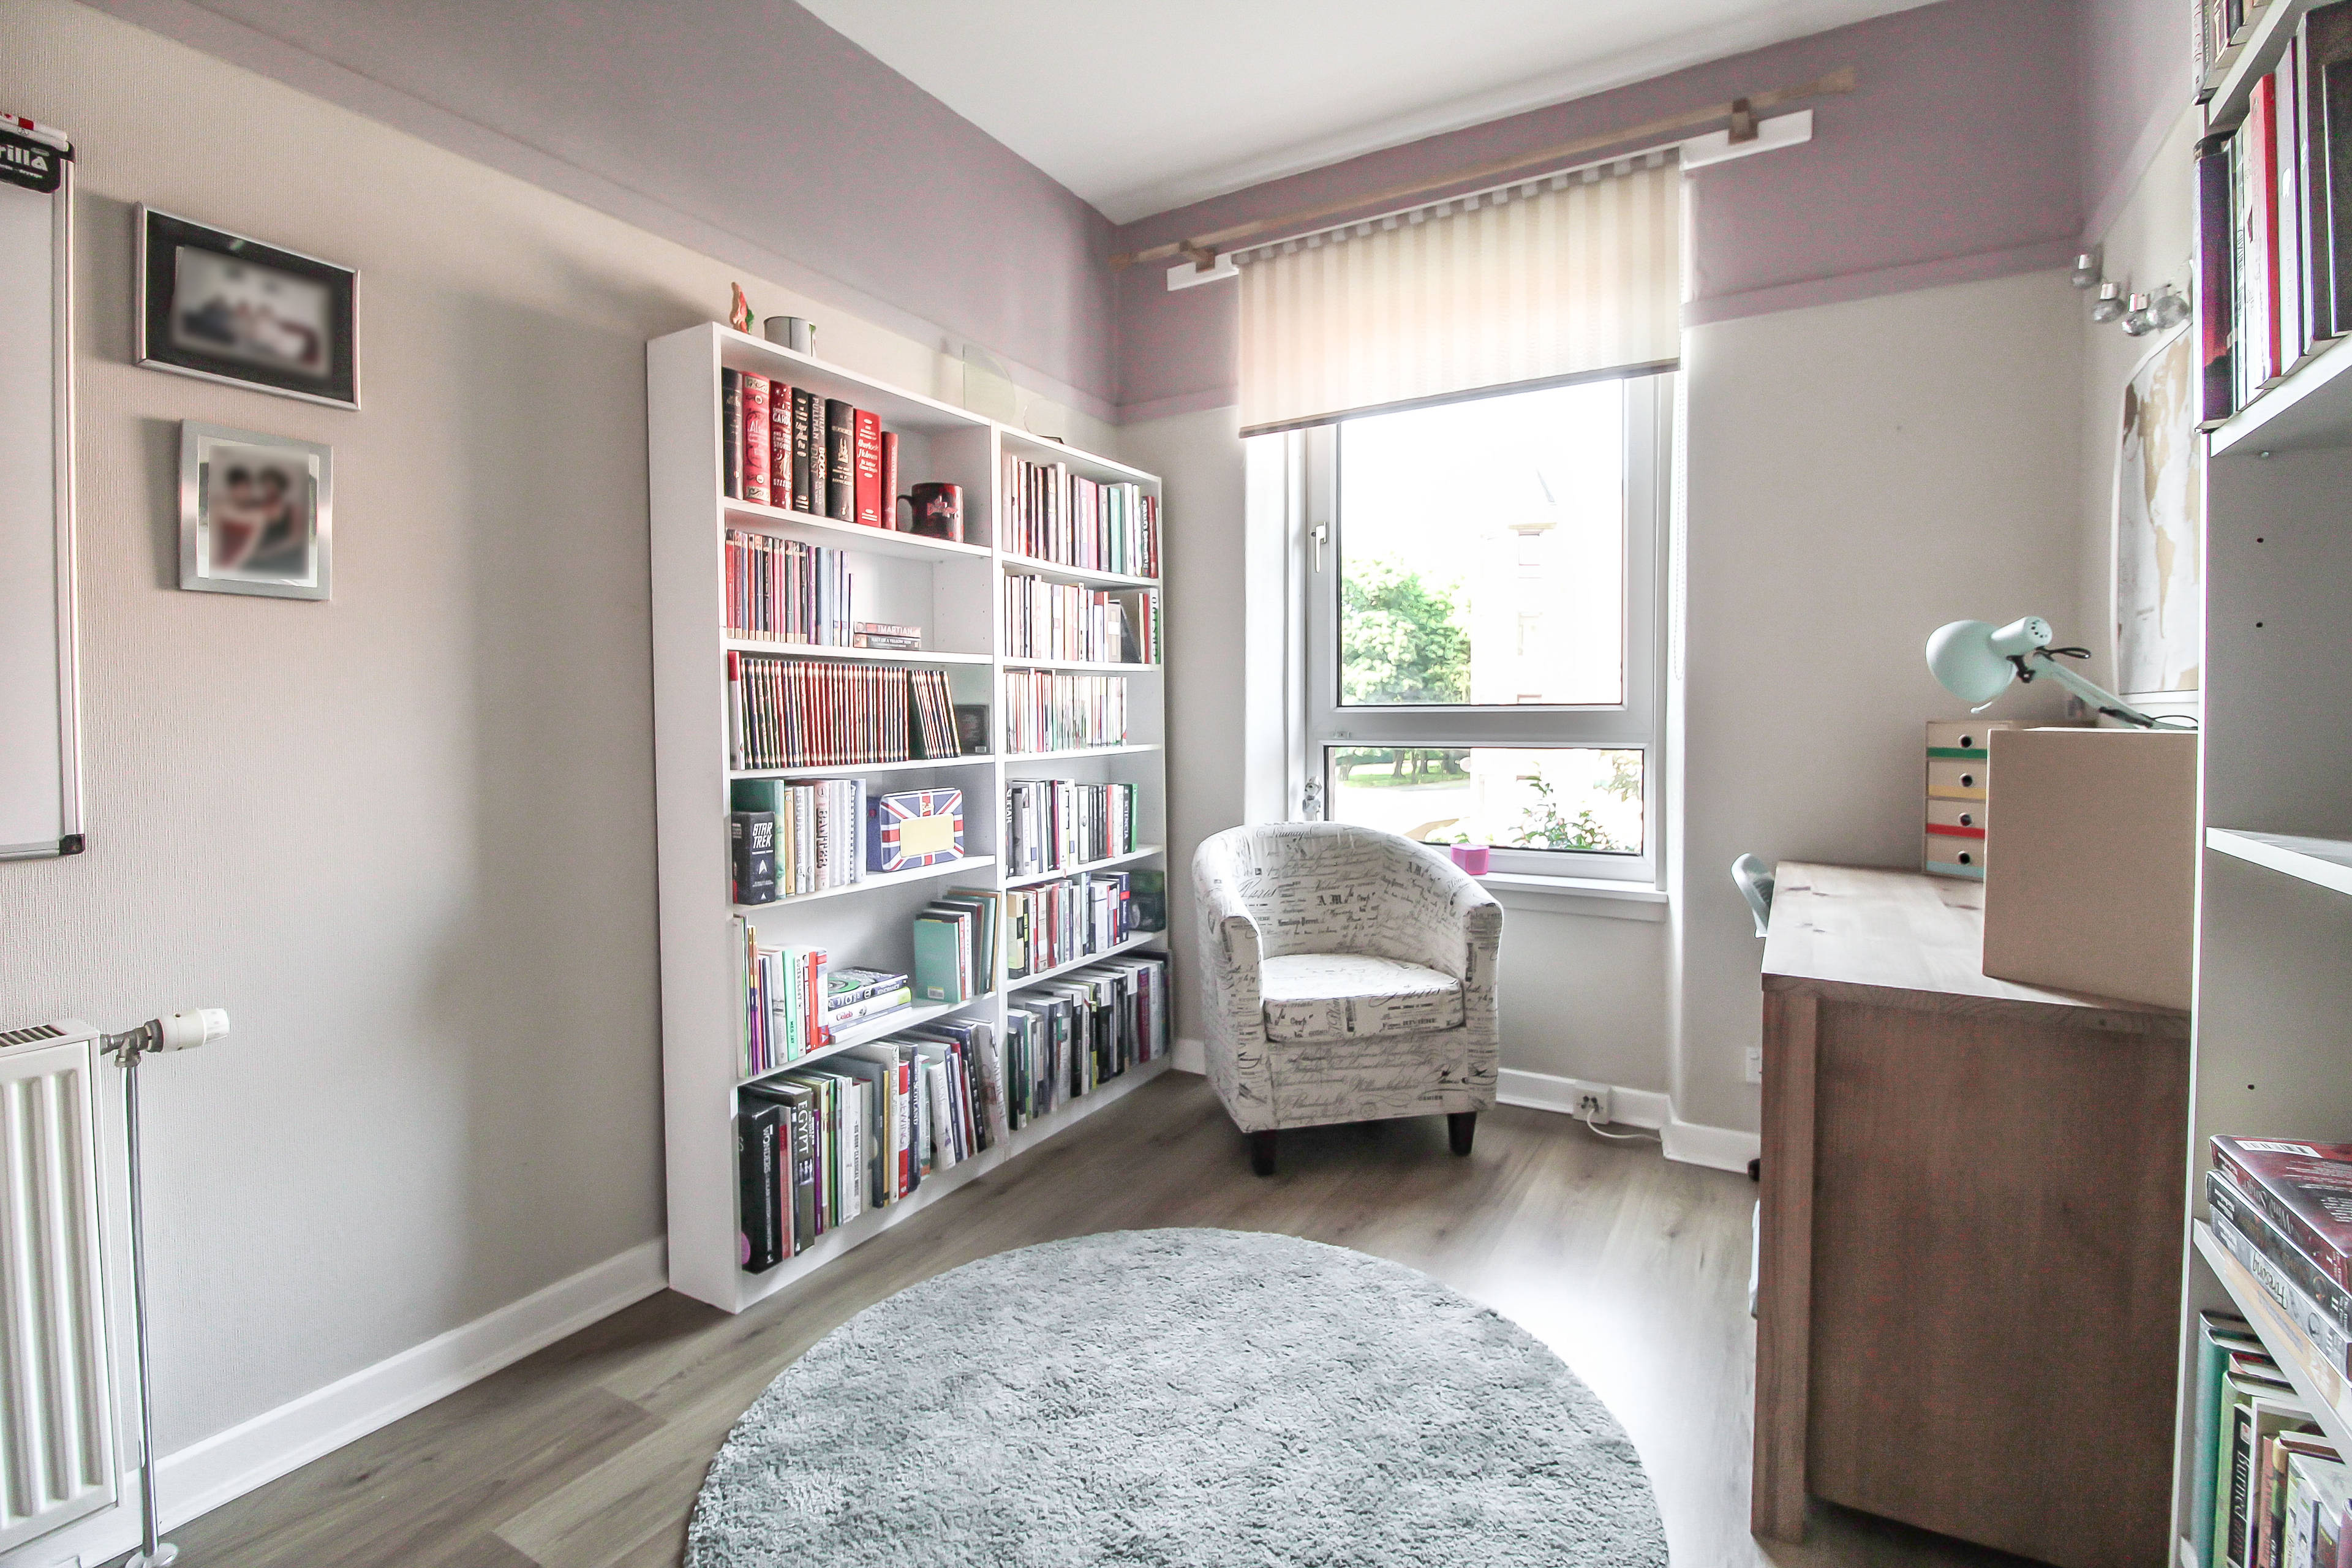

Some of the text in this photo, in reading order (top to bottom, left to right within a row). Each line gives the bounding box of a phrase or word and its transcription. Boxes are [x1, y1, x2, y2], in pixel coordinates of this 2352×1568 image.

[753, 822, 773, 836] STAR
[753, 834, 772, 849] TREK
[816, 808, 828, 869] BANTER
[797, 1099, 809, 1154] EGYPT
[899, 1101, 908, 1150] SEWING
[763, 1128, 772, 1174] WONDERS
[2234, 1451, 2250, 1522] Burned
